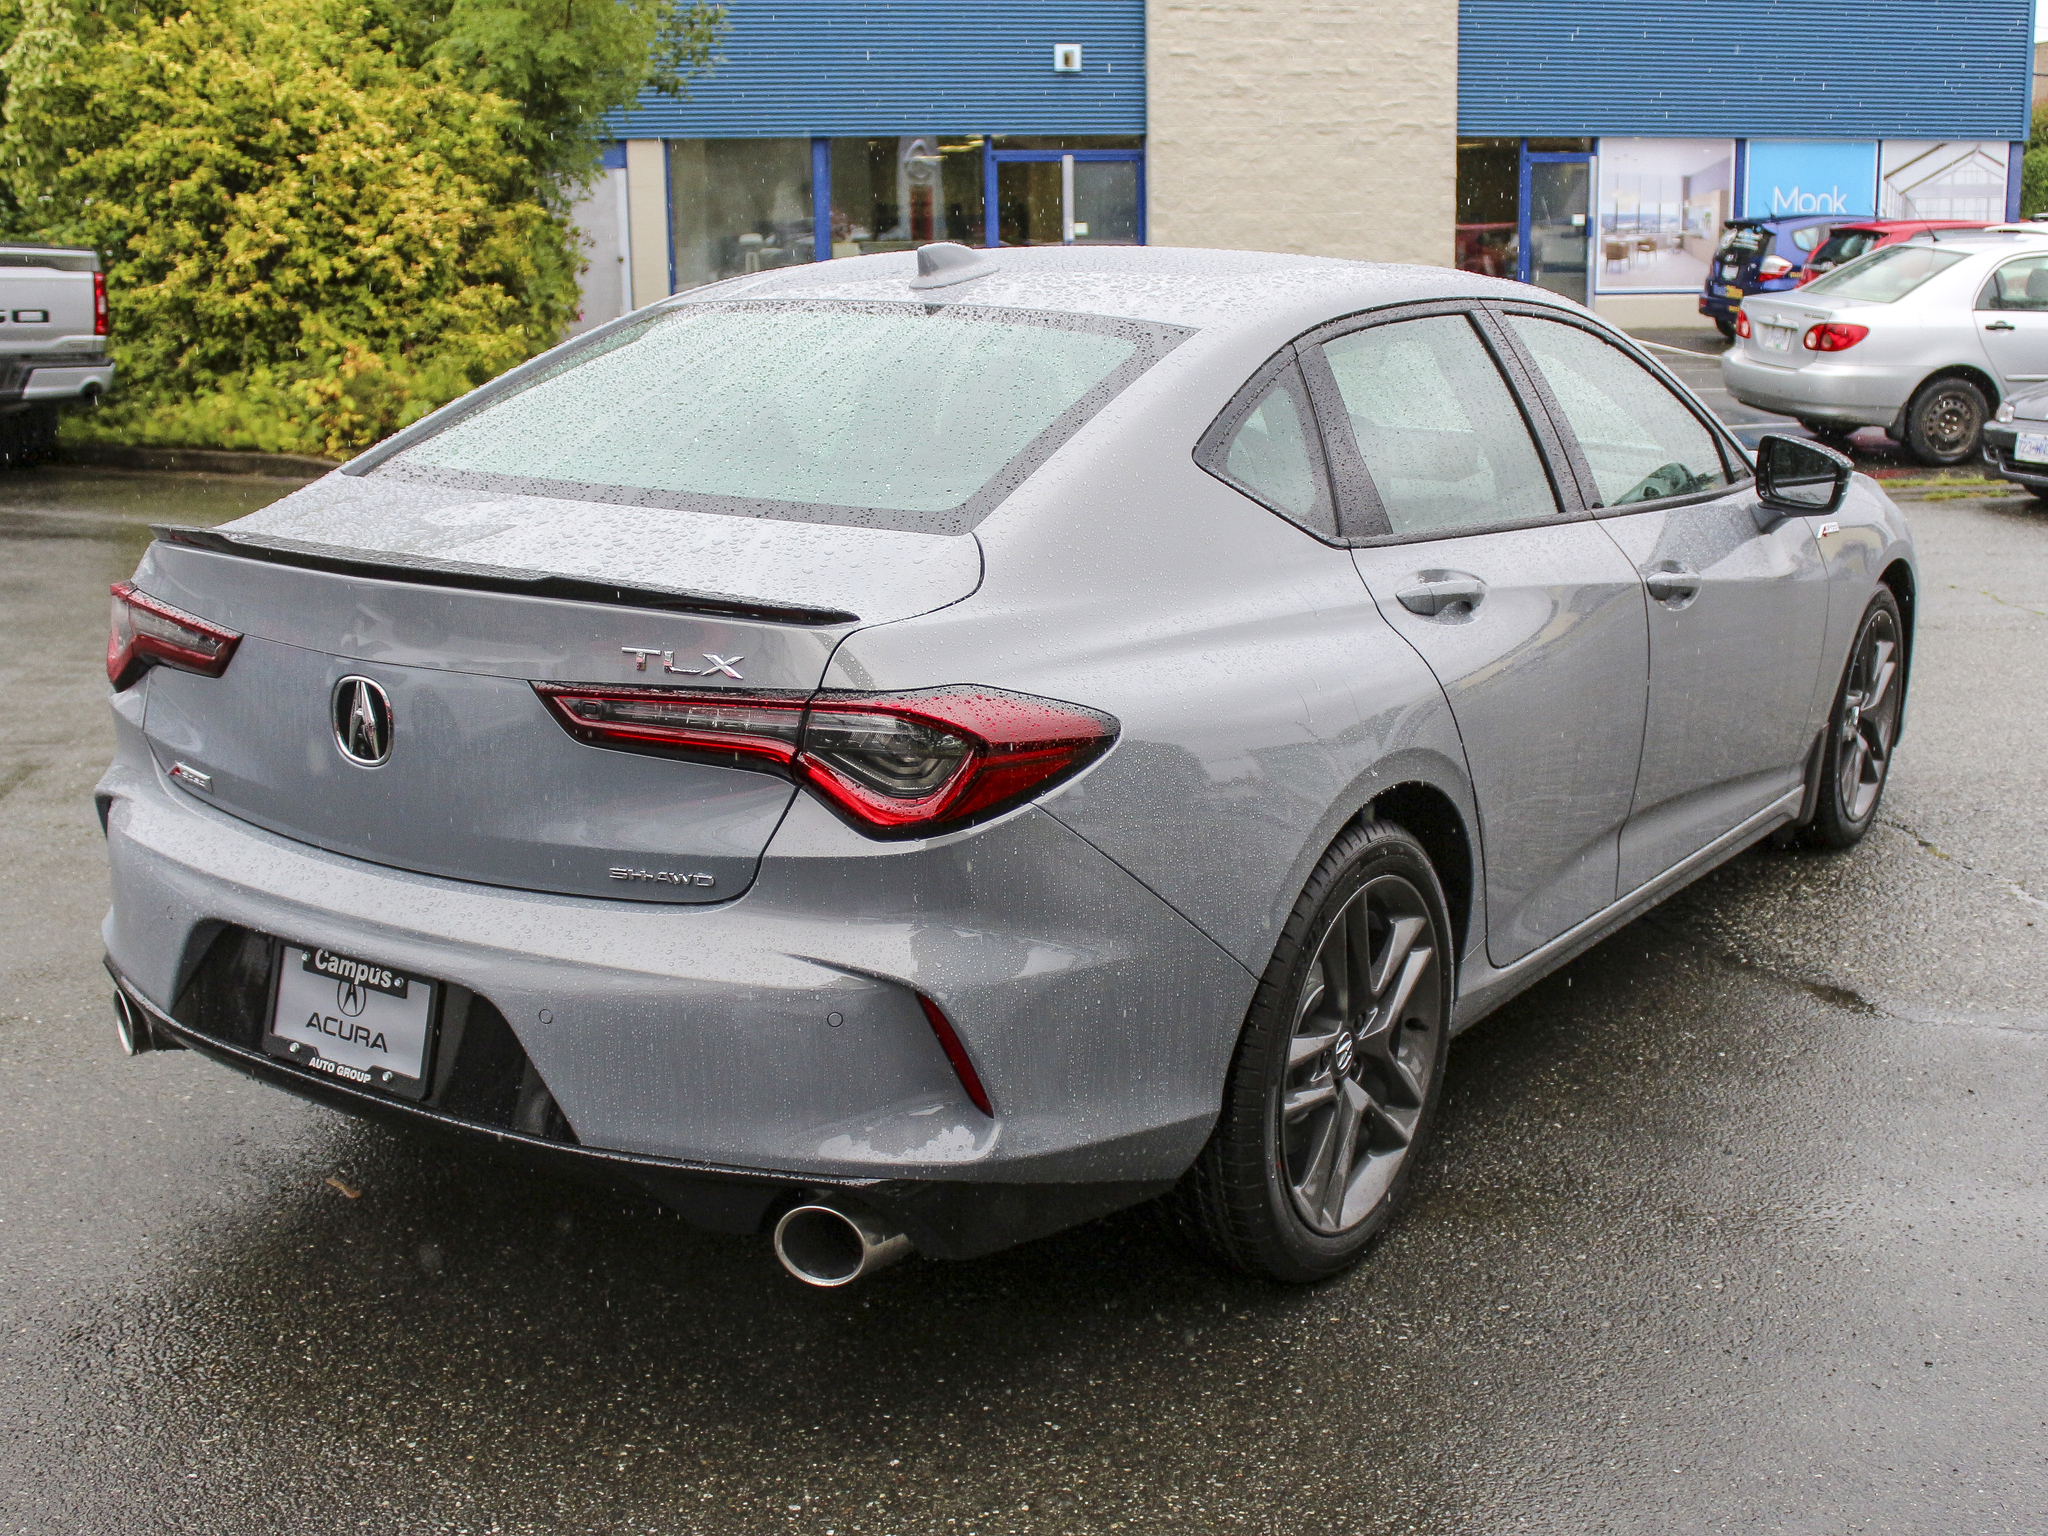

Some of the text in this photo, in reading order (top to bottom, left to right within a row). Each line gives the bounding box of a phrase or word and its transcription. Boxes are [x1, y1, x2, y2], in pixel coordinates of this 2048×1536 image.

[1773, 185, 1848, 214] Monk
[621, 646, 745, 680] TLX
[314, 948, 393, 989] Campus
[305, 1012, 388, 1054] ACURA
[308, 1057, 372, 1083] AUTO GROUP
